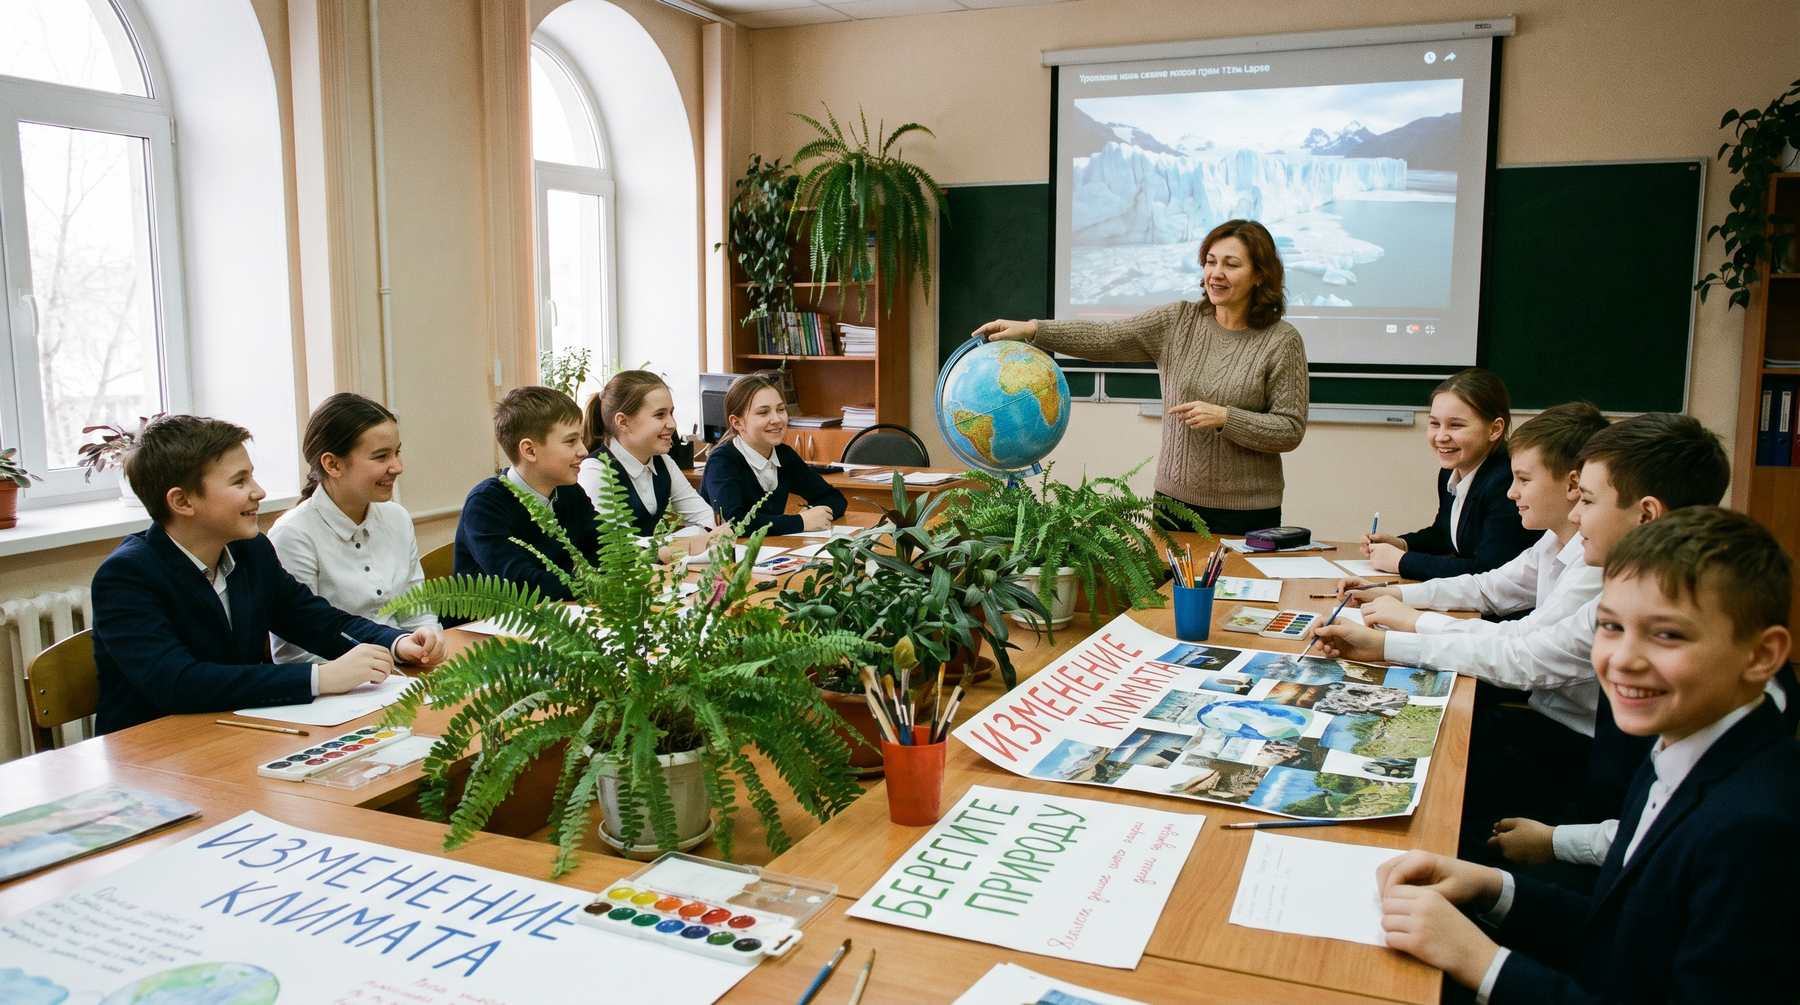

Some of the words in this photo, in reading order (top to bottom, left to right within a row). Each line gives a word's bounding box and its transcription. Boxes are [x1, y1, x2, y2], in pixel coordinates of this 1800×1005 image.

[1243, 64, 1270, 74] Lapse
[969, 633, 1143, 762] ИЗМЕНЕНИЕ
[1079, 661, 1185, 730] КЛИМАТА
[197, 823, 581, 941] ИЗМЕНЕНИЕ
[871, 798, 1020, 919] БЕРЕГИТЕ
[964, 803, 1087, 916] ПРИРОДУ
[200, 880, 502, 978] КЛИМАТА
